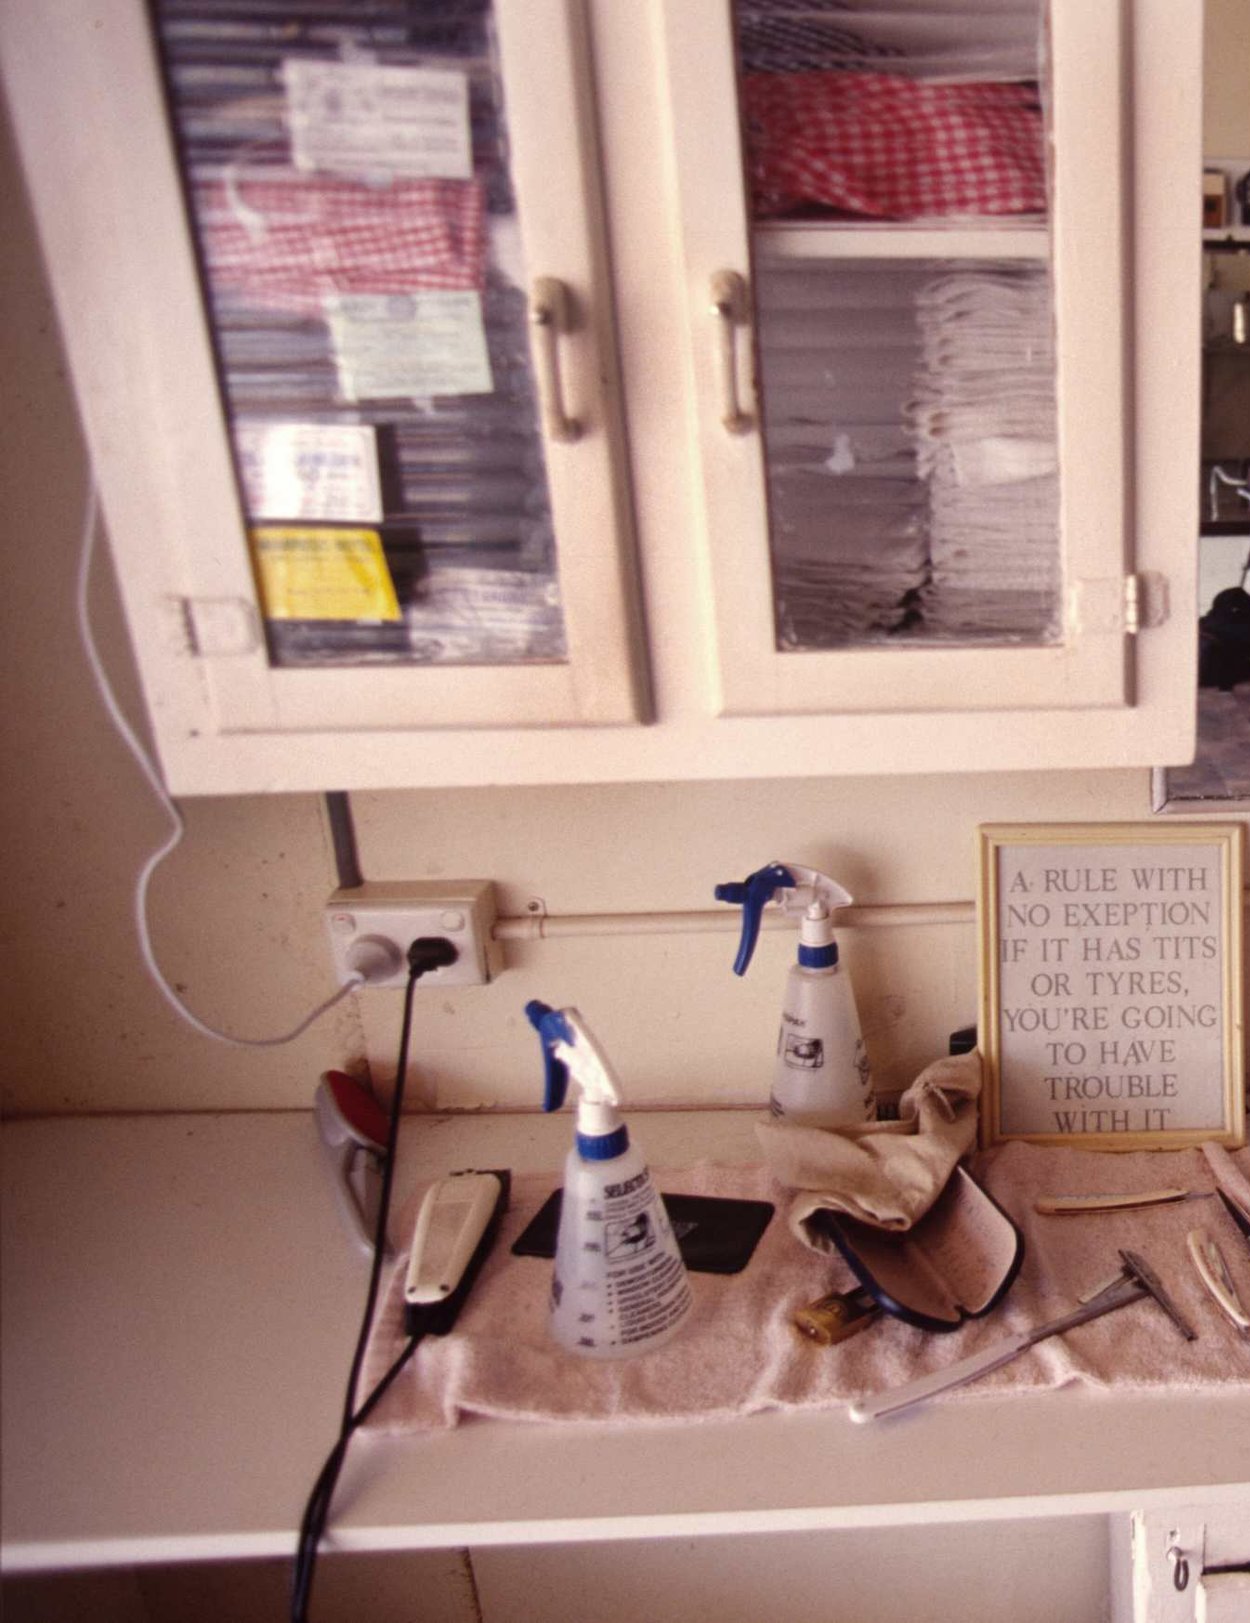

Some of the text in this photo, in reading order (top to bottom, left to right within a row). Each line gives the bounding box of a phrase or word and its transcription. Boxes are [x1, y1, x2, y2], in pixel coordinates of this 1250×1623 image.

[1010, 868, 1208, 892] A RULE WITH
[1007, 902, 1210, 927] NO EXEPTION
[1001, 936, 1217, 963] IF IT HAS TITS
[1031, 971, 1189, 997] OR TYRES,
[1003, 1004, 1217, 1032] YOU'RE GOING
[1046, 1040, 1176, 1066] TO HAVE
[1044, 1074, 1178, 1101] TROUBLE
[1053, 1108, 1171, 1133] WITH IT
